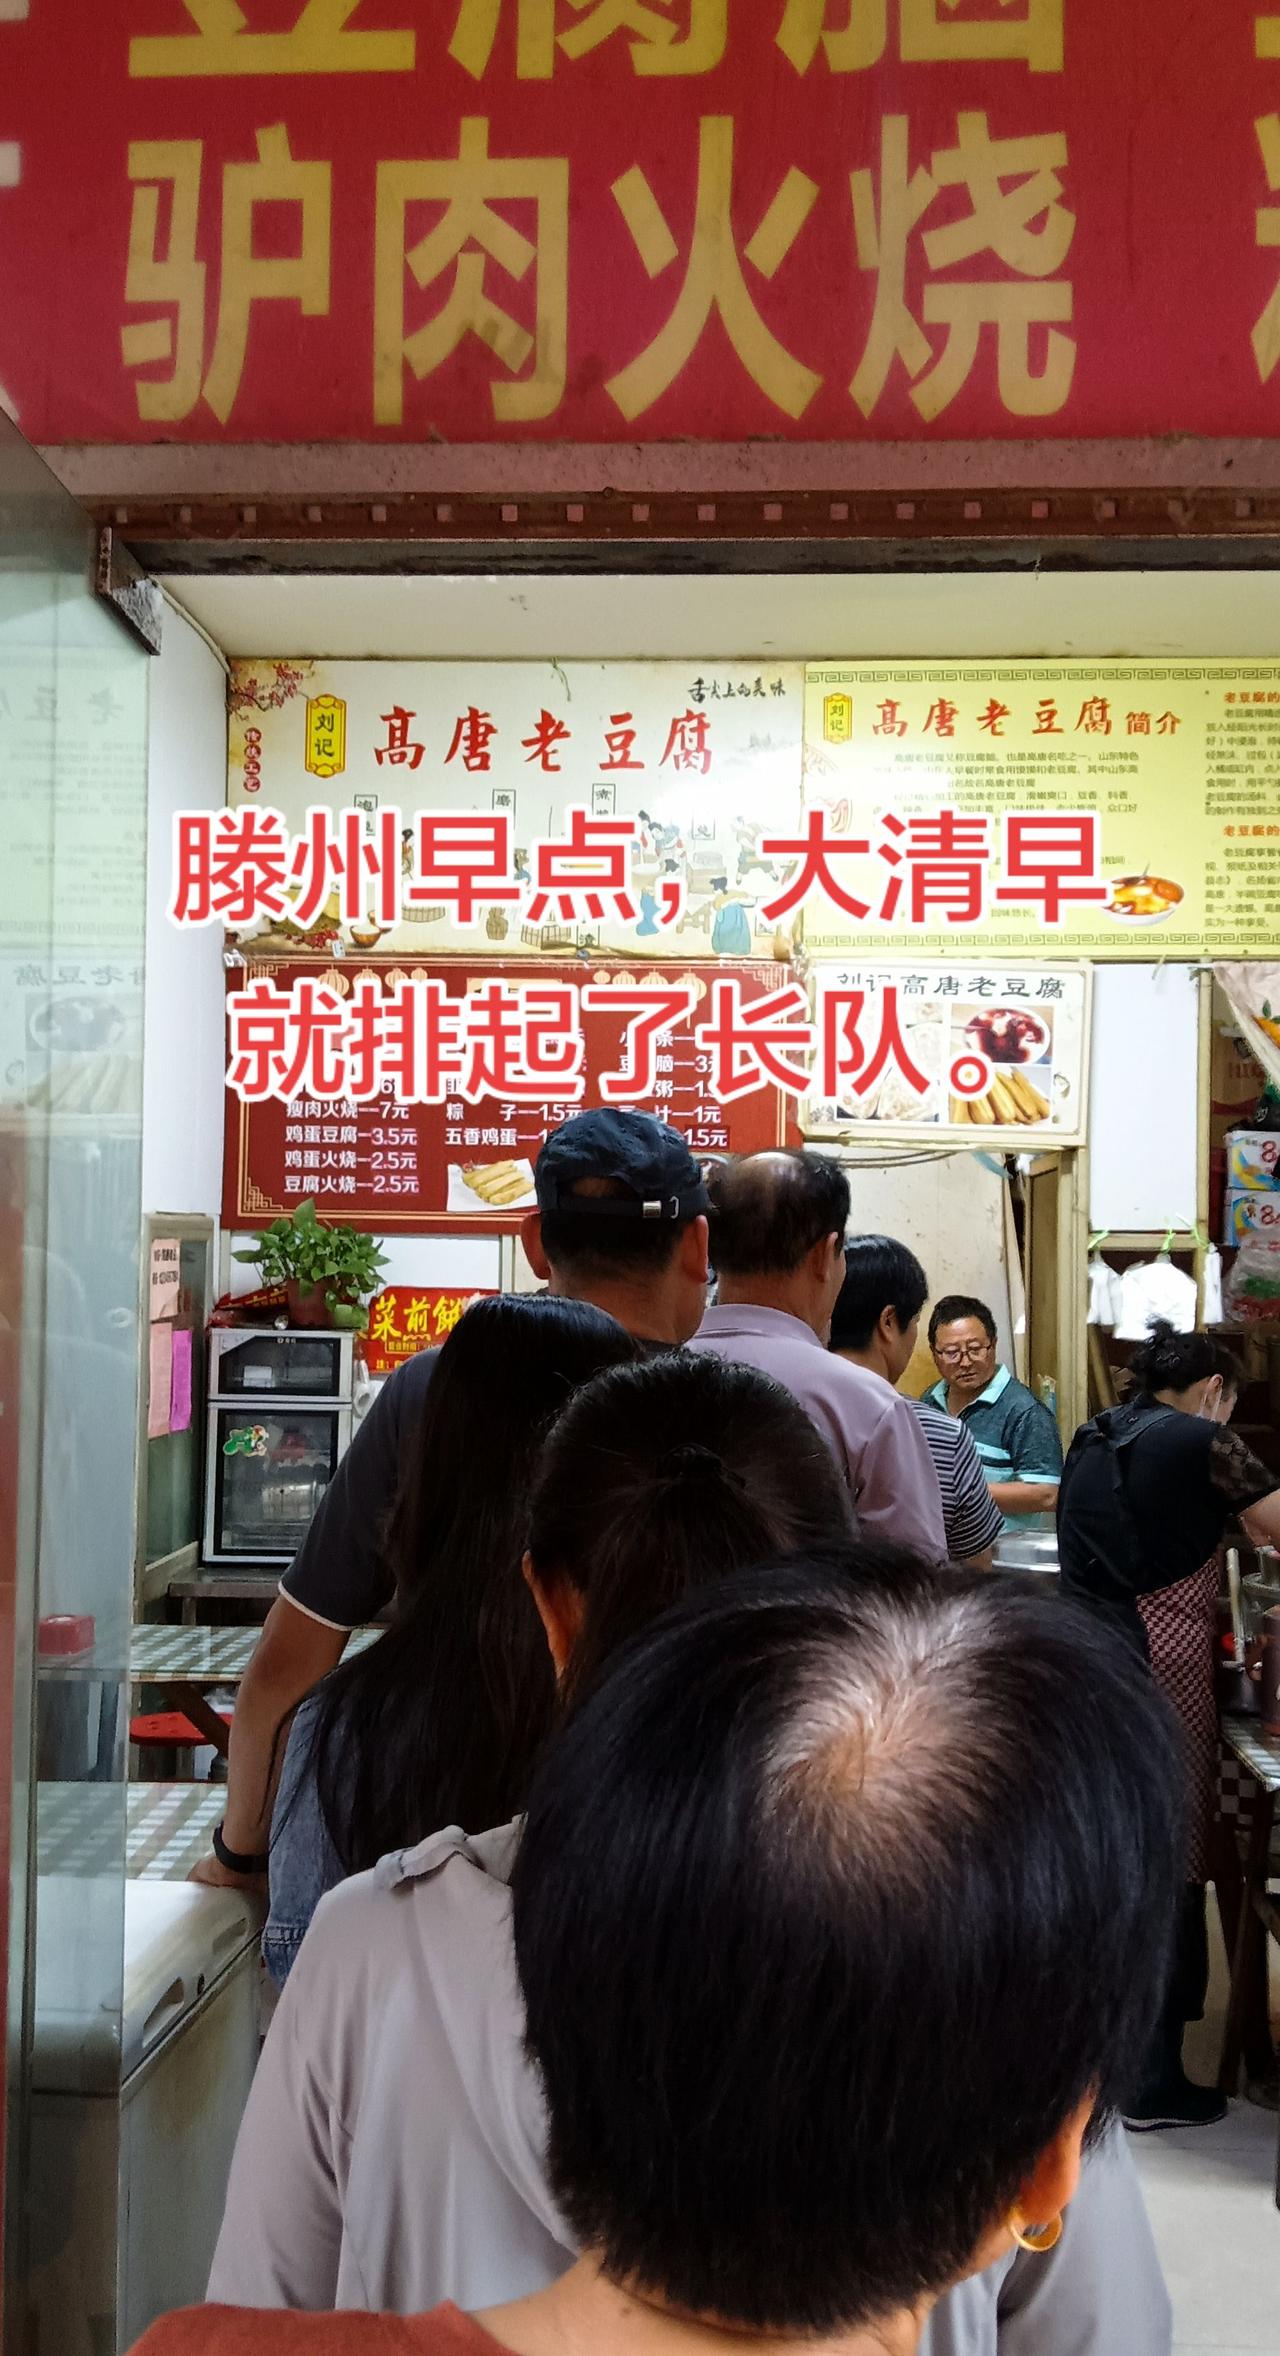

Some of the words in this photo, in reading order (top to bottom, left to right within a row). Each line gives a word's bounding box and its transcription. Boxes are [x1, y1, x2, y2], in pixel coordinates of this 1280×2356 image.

[121, 112, 1077, 425] 驴肉火烧
[688, 677, 787, 703] 舌尖上的美味
[314, 713, 335, 757] 刘记
[829, 704, 844, 732] 刘记
[373, 705, 712, 776] 高唐老豆腐
